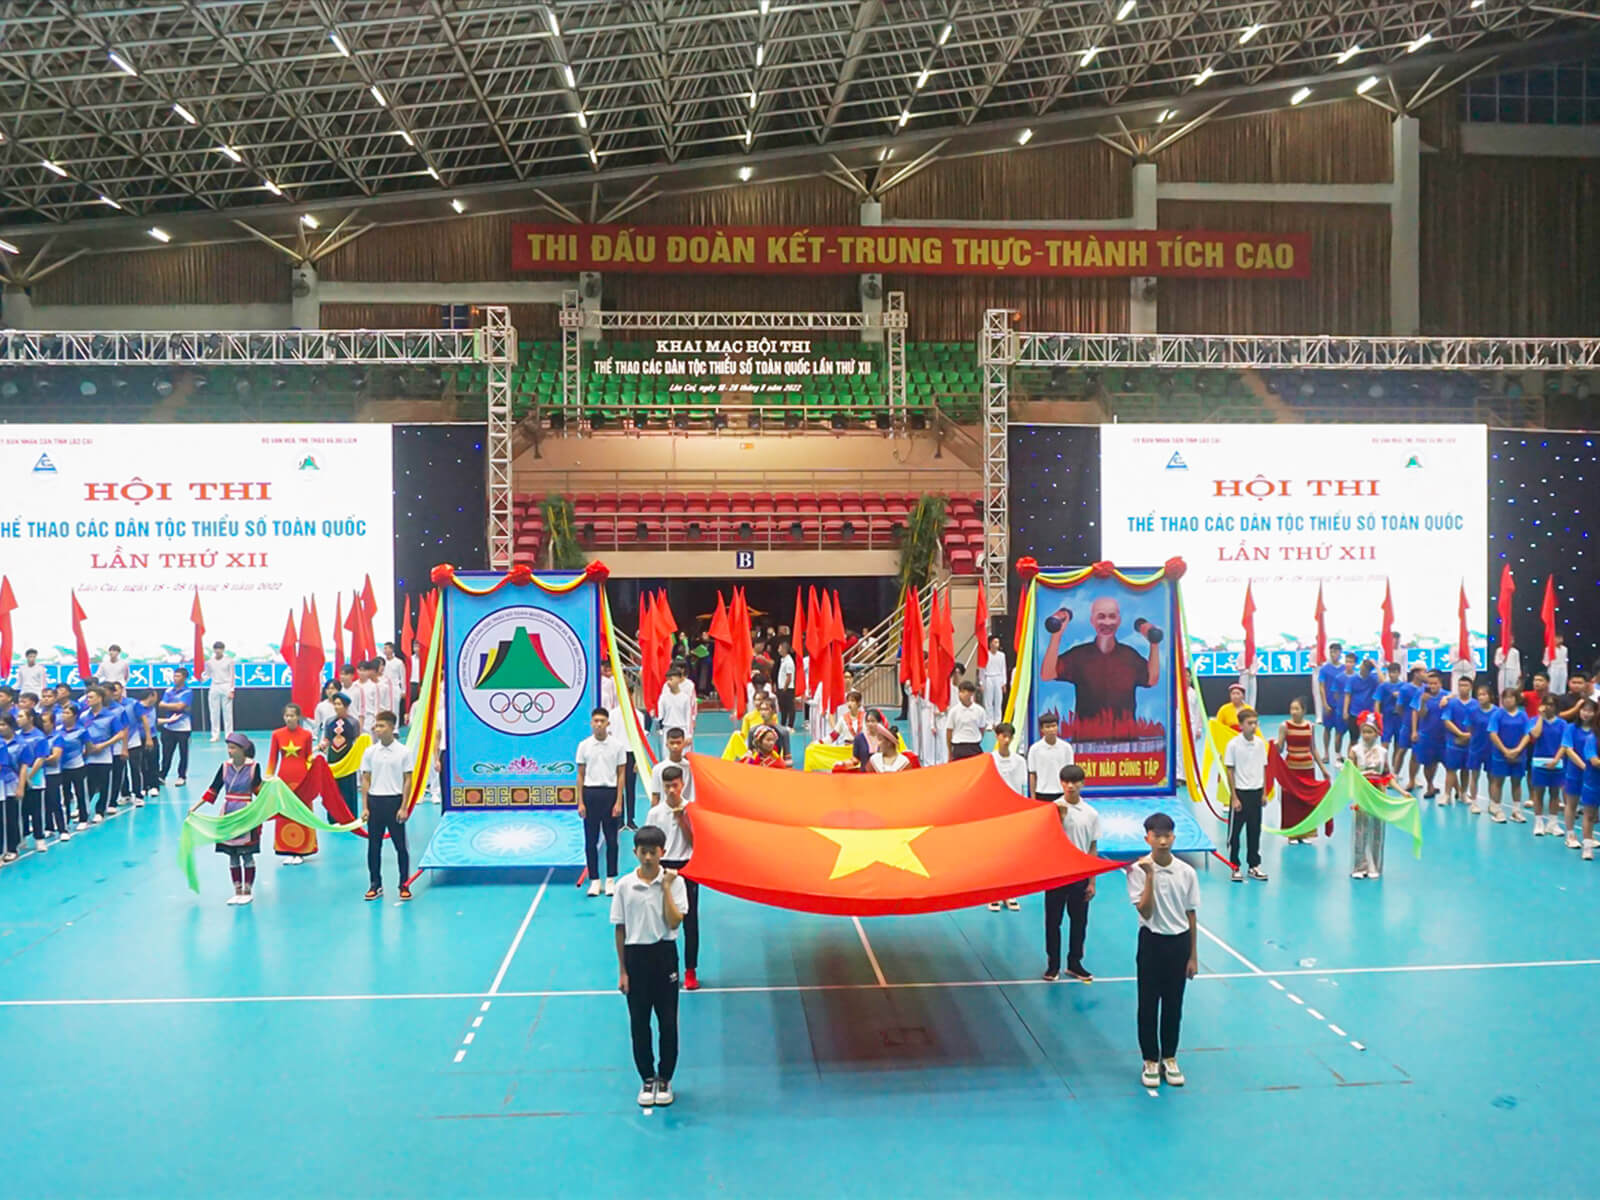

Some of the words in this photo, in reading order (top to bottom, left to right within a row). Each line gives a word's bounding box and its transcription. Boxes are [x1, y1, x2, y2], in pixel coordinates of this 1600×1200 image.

[528, 234, 577, 261] THI
[591, 230, 656, 262] ĐẤU
[667, 232, 755, 263] ĐOÀN
[1157, 236, 1224, 268] TÍCH
[1236, 242, 1294, 269] CAO
[656, 340, 702, 353] KHAI
[706, 340, 743, 356] MẠC
[746, 337, 777, 356] HỘI
[780, 340, 811, 353] THI
[615, 361, 640, 375] THAO
[642, 358, 663, 375] CÁC
[665, 358, 686, 375] DÂN
[688, 358, 707, 377] TỘC
[708, 353, 737, 375] THIỂU
[739, 357, 753, 375] SỐ
[755, 358, 782, 375] TOÀN
[784, 357, 811, 376] QUỐC
[857, 361, 871, 375] XII
[84, 476, 173, 506] HỘI
[189, 482, 272, 501] THI
[1212, 474, 1292, 502] HỘI
[1307, 479, 1380, 497] THI
[0, 514, 22, 538] HỂ
[27, 521, 70, 538] THAO
[75, 518, 109, 538] CÁC
[115, 517, 150, 538] DÂN
[155, 517, 187, 541] TỘC
[192, 514, 239, 537] THIỂU
[244, 515, 267, 537] SỐ
[272, 516, 317, 537] TOÀN
[322, 514, 368, 538] QUỐC
[1127, 510, 1156, 533] THỂ
[1160, 516, 1199, 533] THAO
[1204, 512, 1235, 532] CÁC
[1240, 512, 1272, 532] DÂN
[1276, 512, 1305, 535] TỘC
[1309, 510, 1352, 531] THIỂU
[1356, 511, 1376, 531] SỐ
[1381, 512, 1420, 531] TOÀN
[1424, 511, 1465, 532] QUỐC
[91, 546, 150, 569] LẦN
[159, 548, 219, 569] THỨ
[225, 552, 269, 568] XII
[738, 552, 752, 569] B
[1218, 540, 1271, 561] LẦN
[1279, 541, 1333, 561] THỨ
[1339, 546, 1377, 561] XII
[1099, 758, 1117, 777] NÀO
[1119, 758, 1142, 777] CŨNG
[1143, 757, 1160, 780] TẬP
